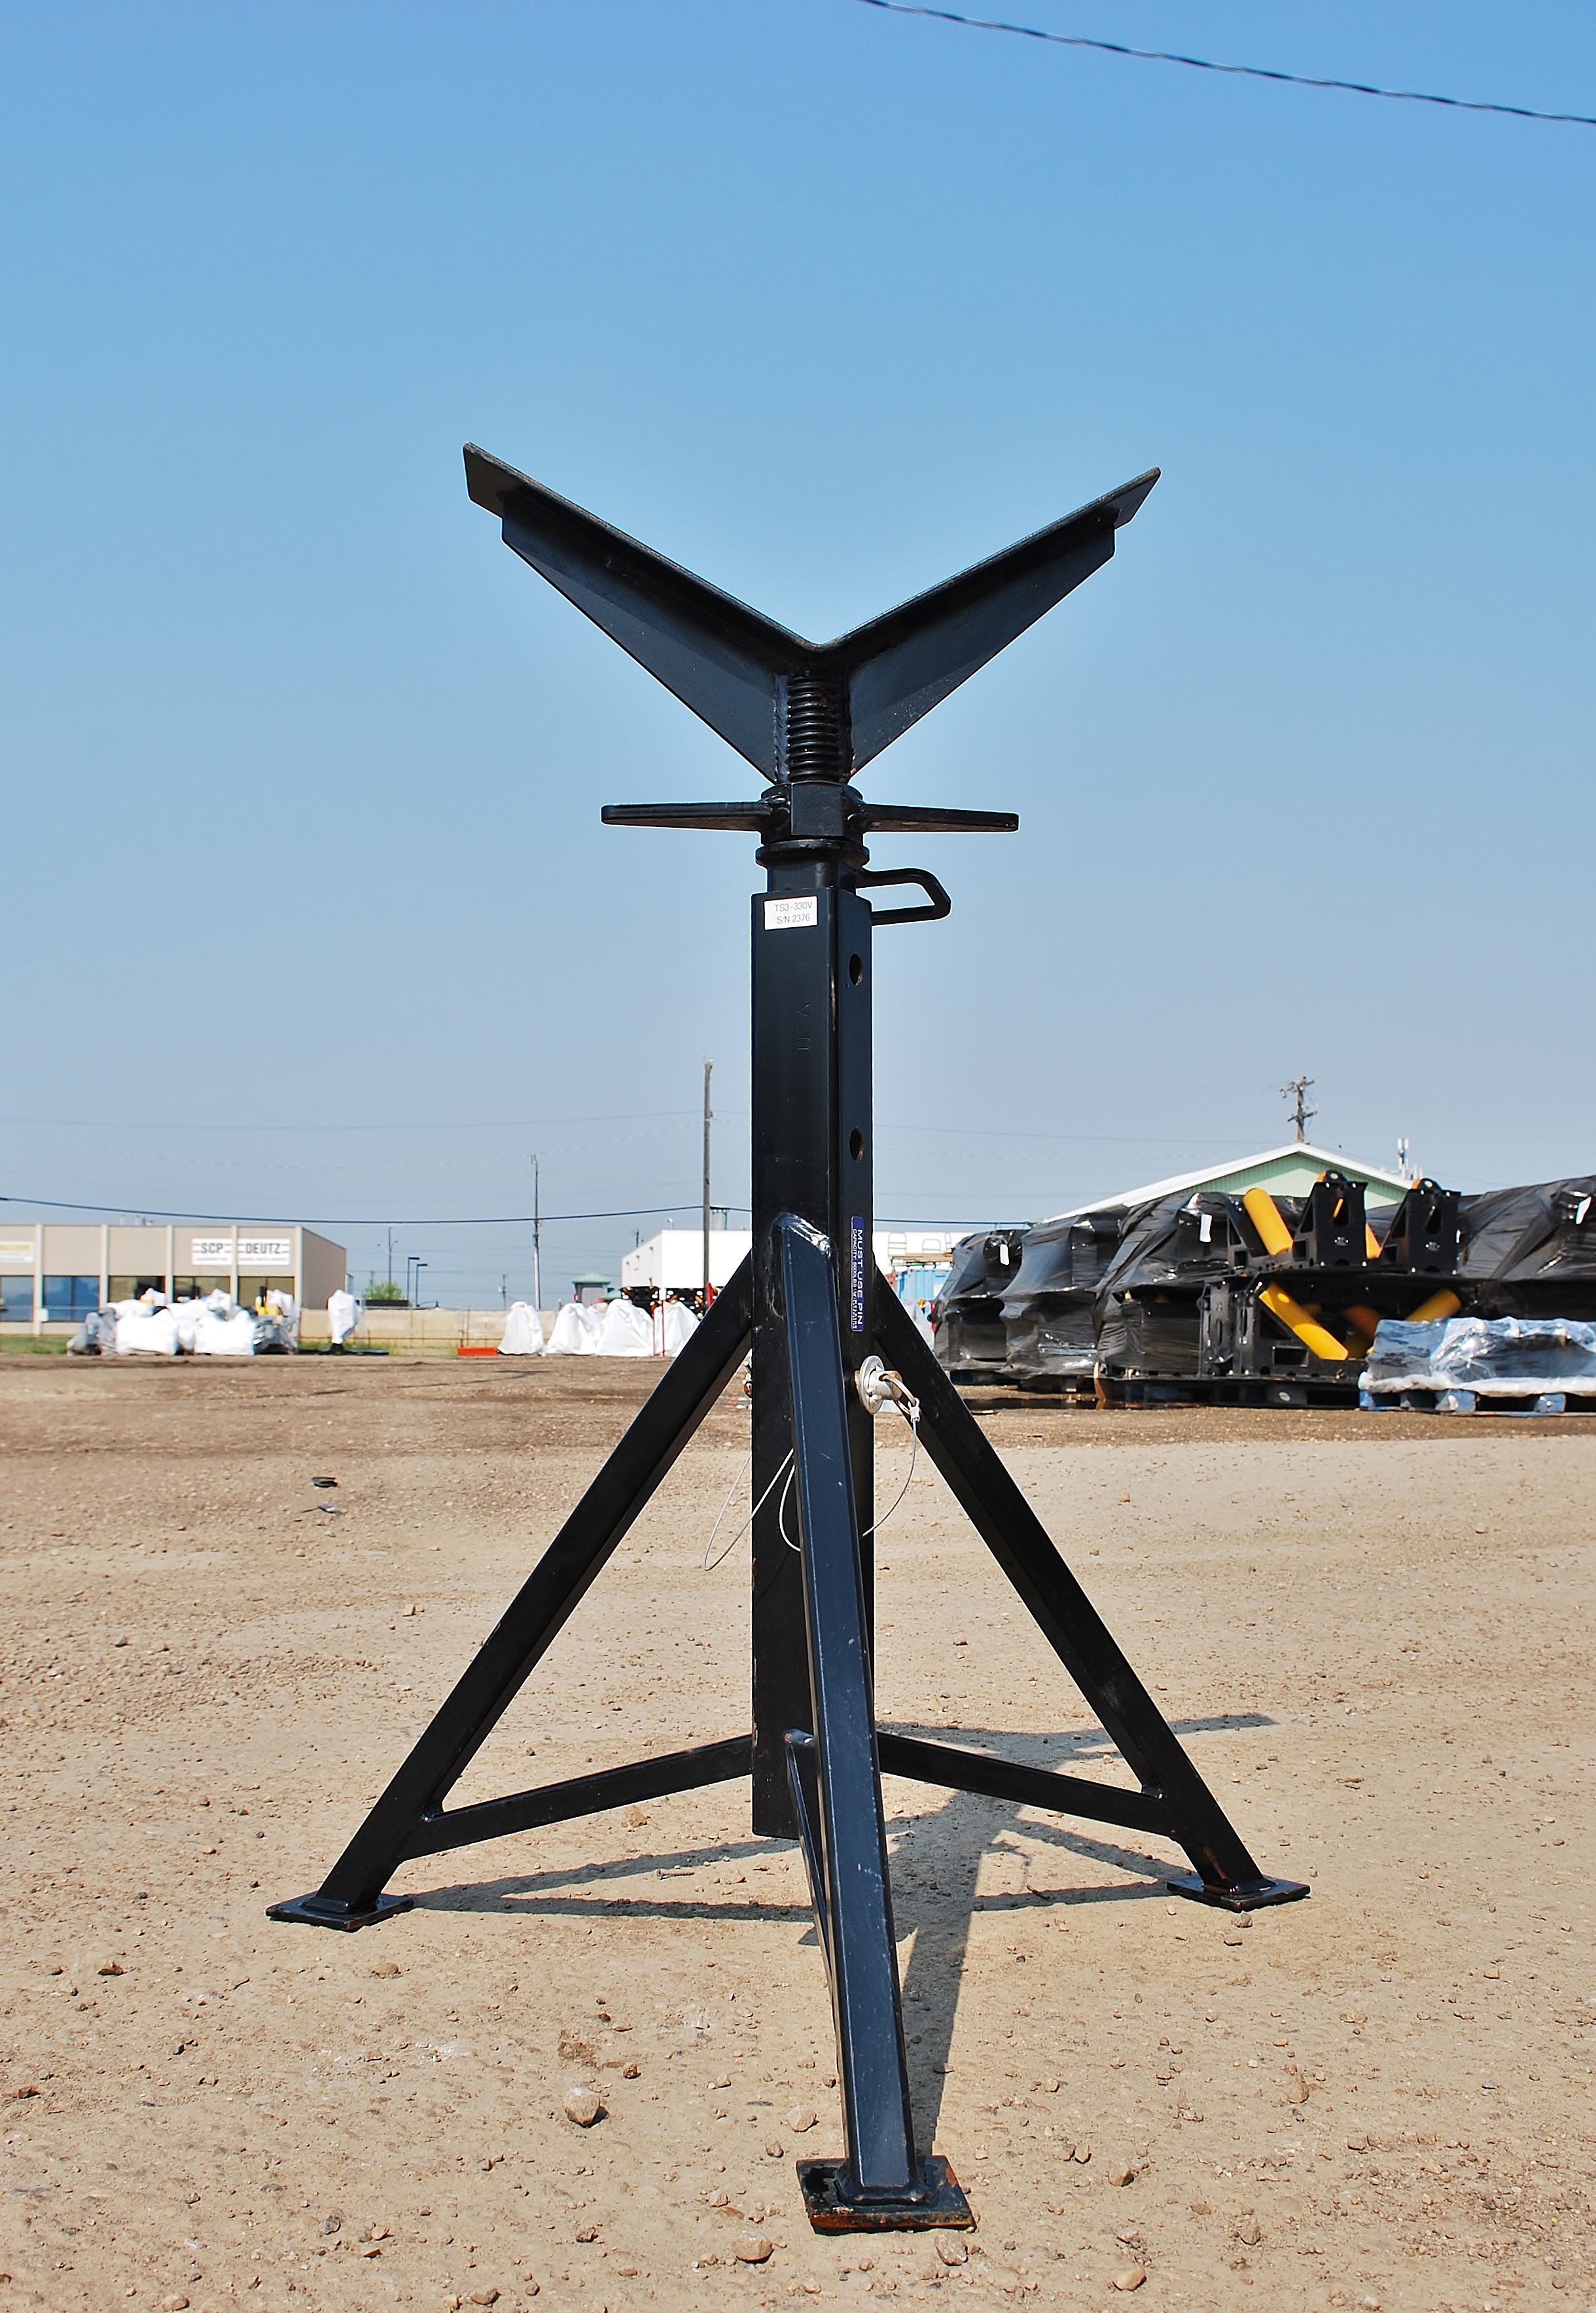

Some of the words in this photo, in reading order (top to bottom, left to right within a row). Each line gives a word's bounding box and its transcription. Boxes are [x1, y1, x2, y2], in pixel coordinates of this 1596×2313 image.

[774, 901, 813, 912] TS3-330V
[776, 915, 790, 925] S/N
[792, 913, 810, 923] 2376
[201, 1243, 223, 1254] SCP
[245, 1243, 280, 1254] DEUTZ
